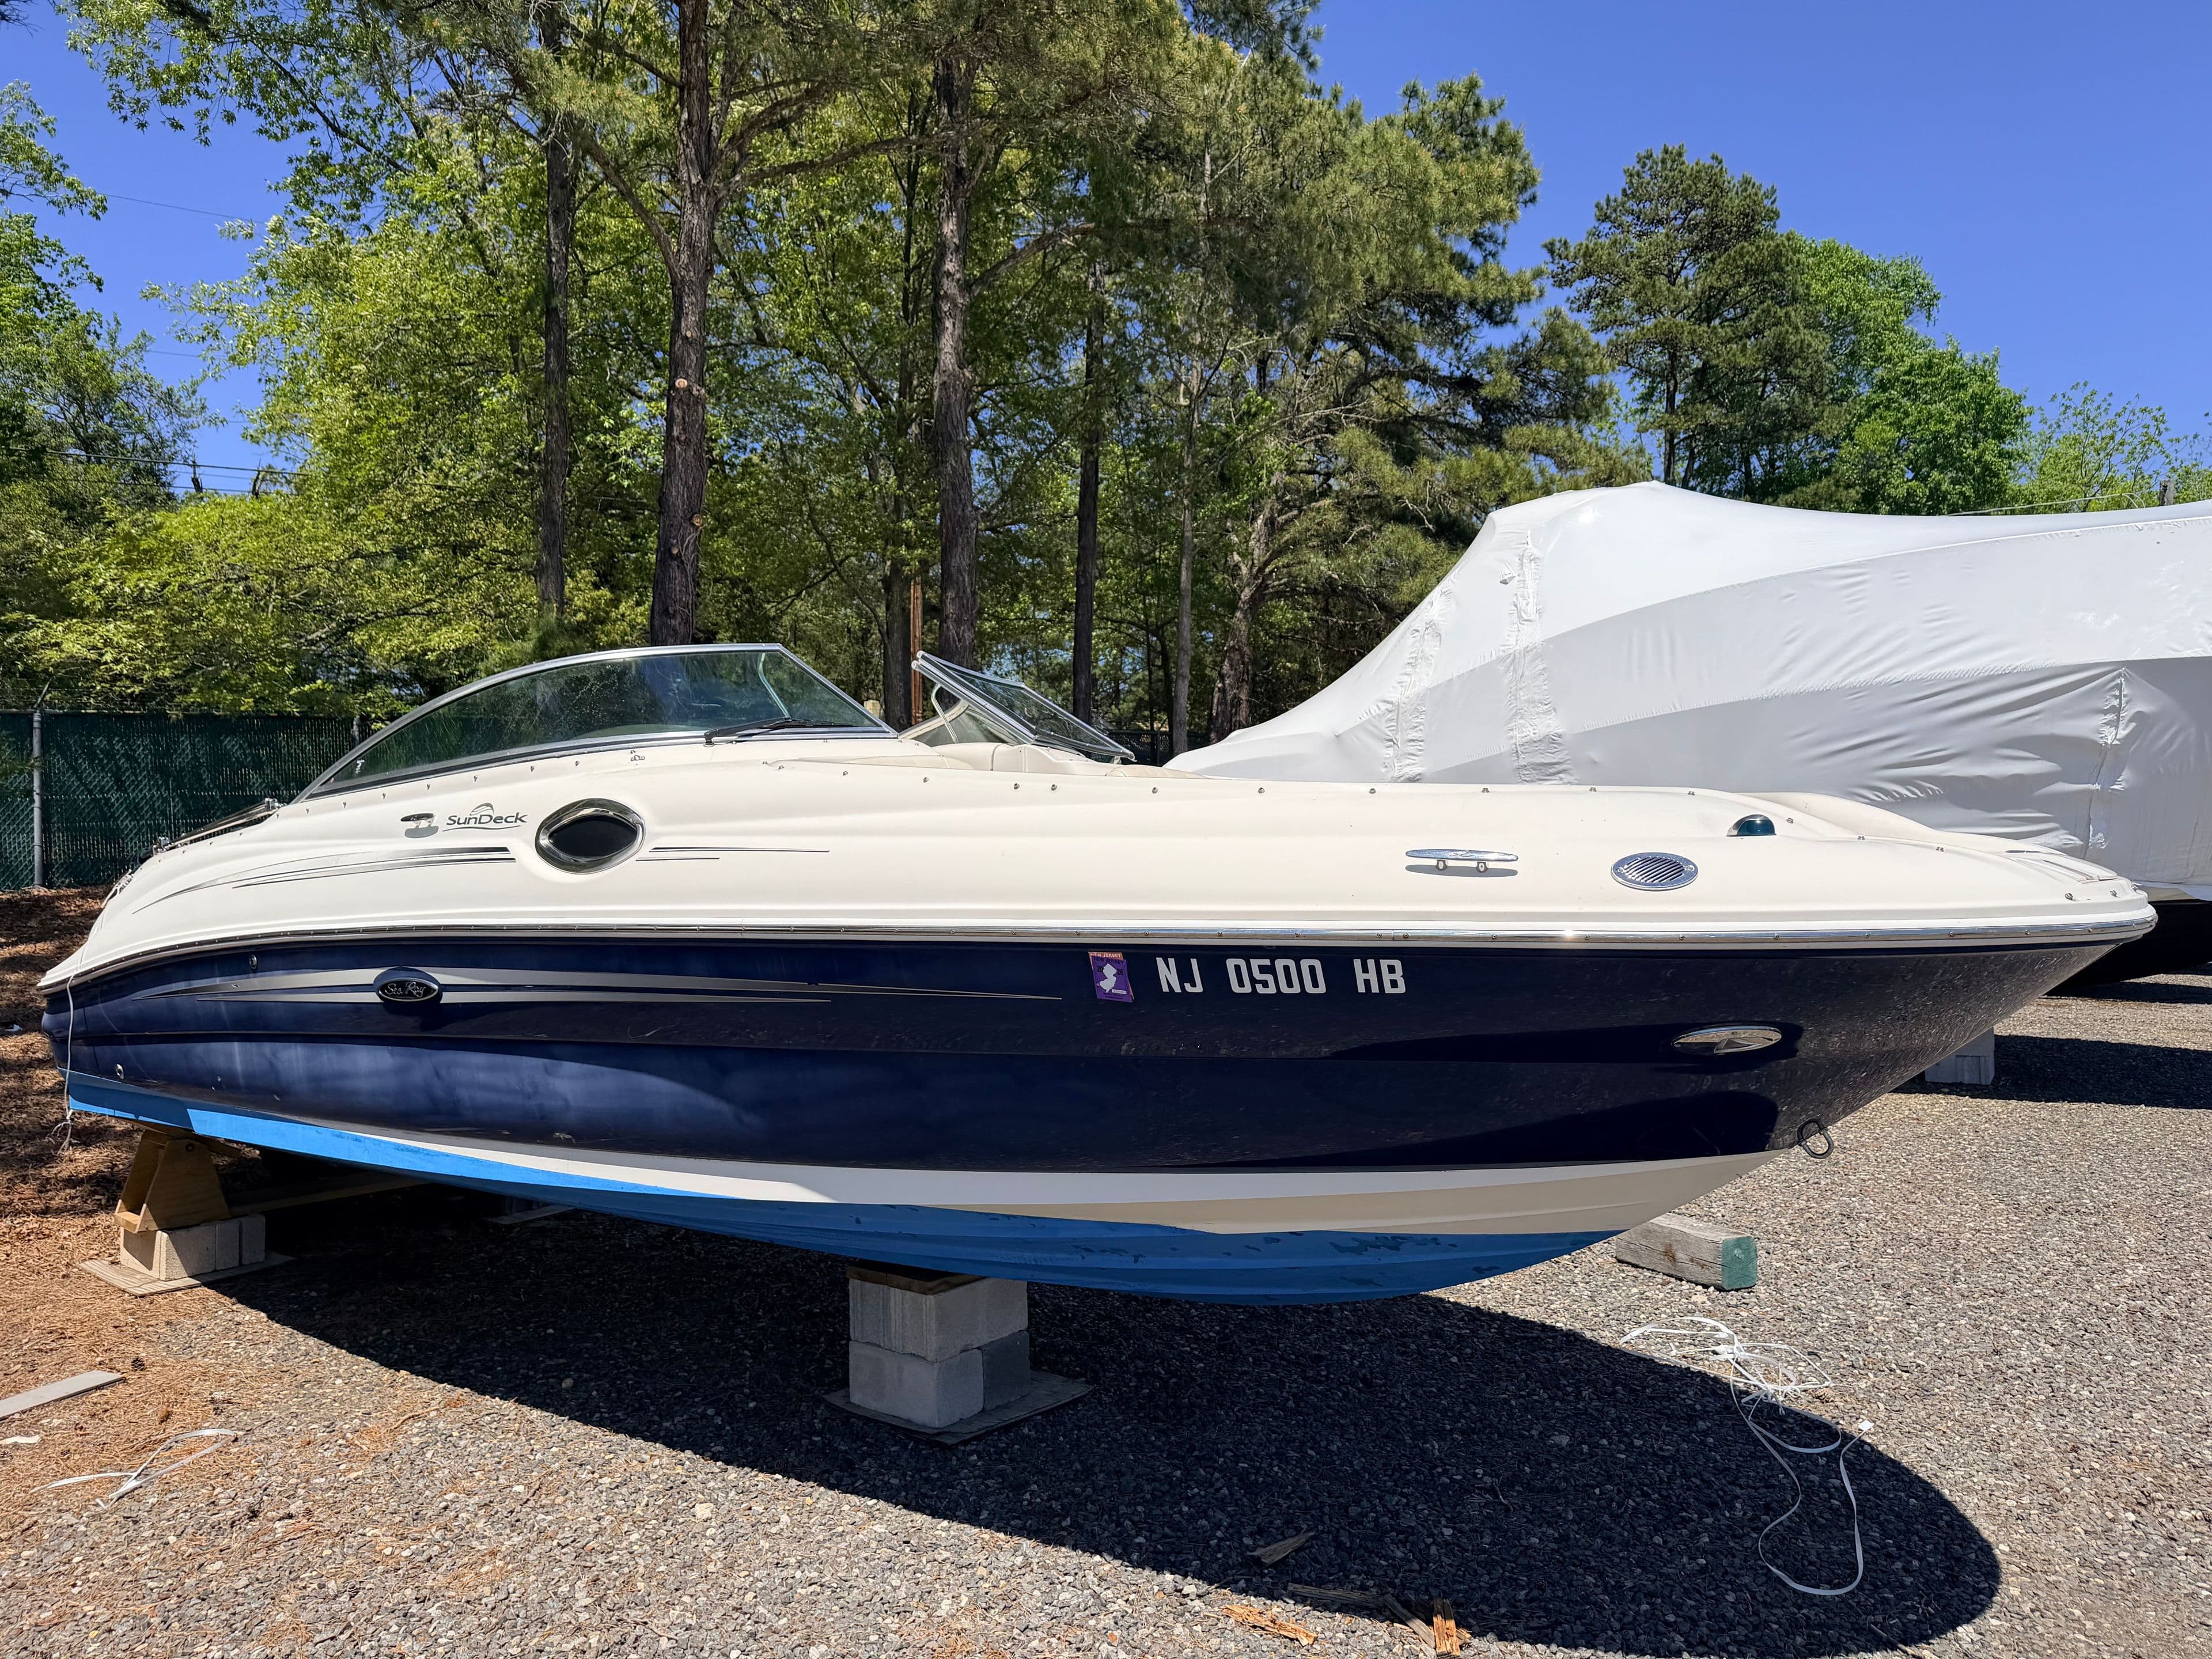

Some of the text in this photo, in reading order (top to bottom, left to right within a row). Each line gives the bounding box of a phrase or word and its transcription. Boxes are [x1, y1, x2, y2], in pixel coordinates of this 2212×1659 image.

[446, 812, 528, 825] SunDeck
[1156, 957, 1406, 994] NJ 0500 HB
[385, 981, 426, 997] Sea Ray
